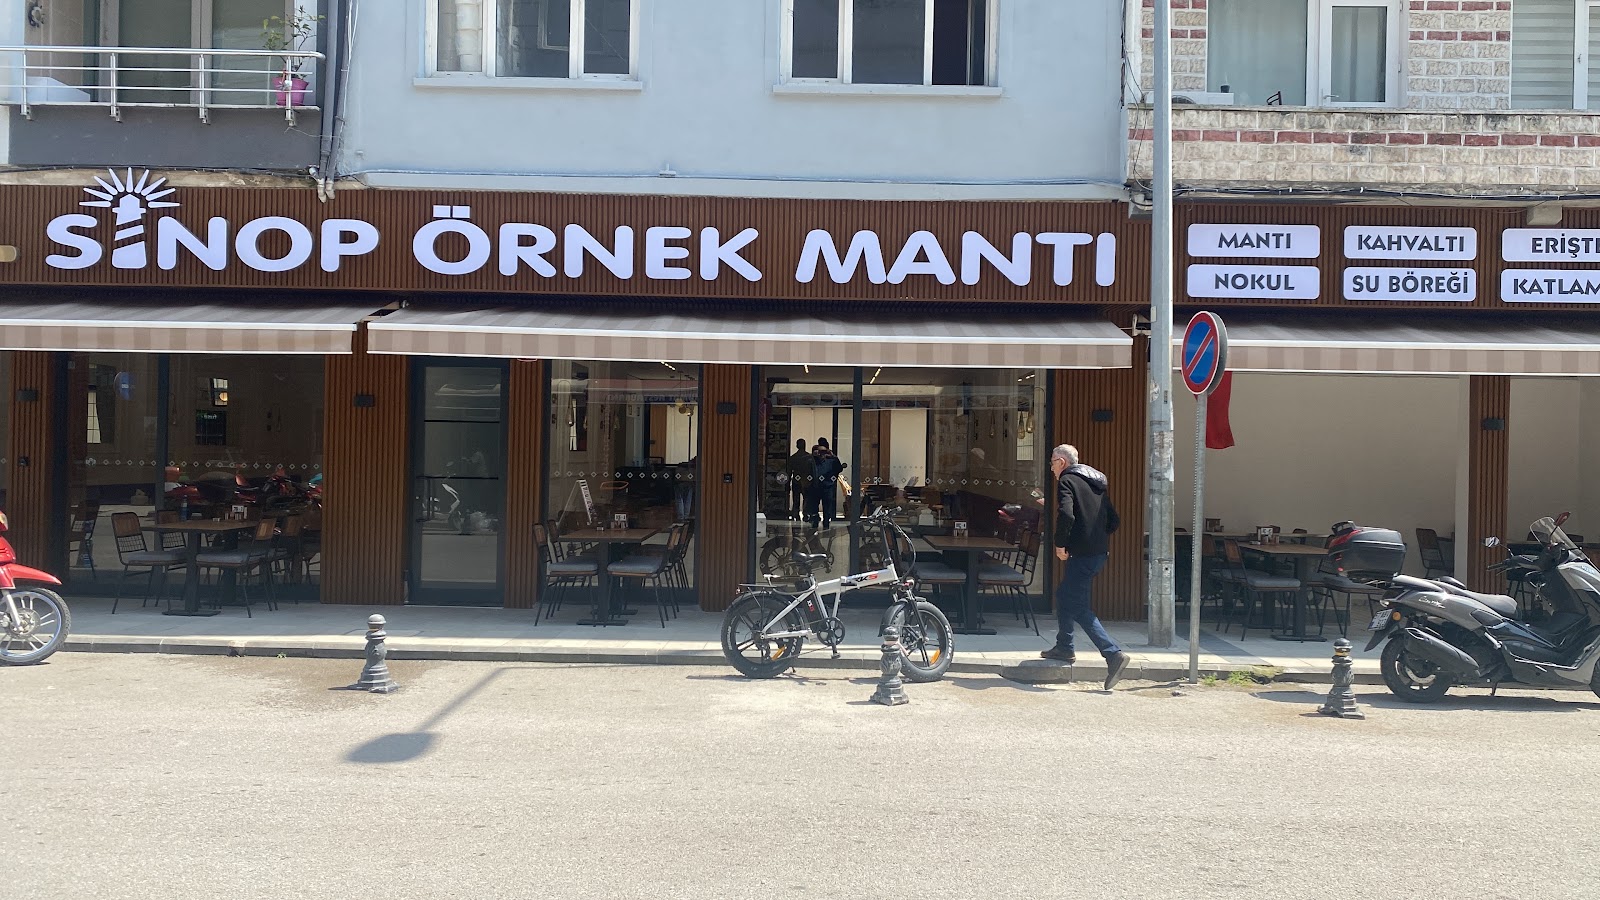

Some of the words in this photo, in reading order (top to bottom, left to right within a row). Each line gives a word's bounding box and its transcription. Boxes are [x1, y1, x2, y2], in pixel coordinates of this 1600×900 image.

[412, 204, 763, 283] ÖRNEK
[795, 229, 1116, 287] MANTI
[1217, 231, 1292, 249] MANTI
[1357, 234, 1465, 253] KAHVALTI
[1214, 273, 1296, 291] NOKUL
[1352, 274, 1380, 293] SU
[1388, 270, 1469, 294] BÖREĞİ
